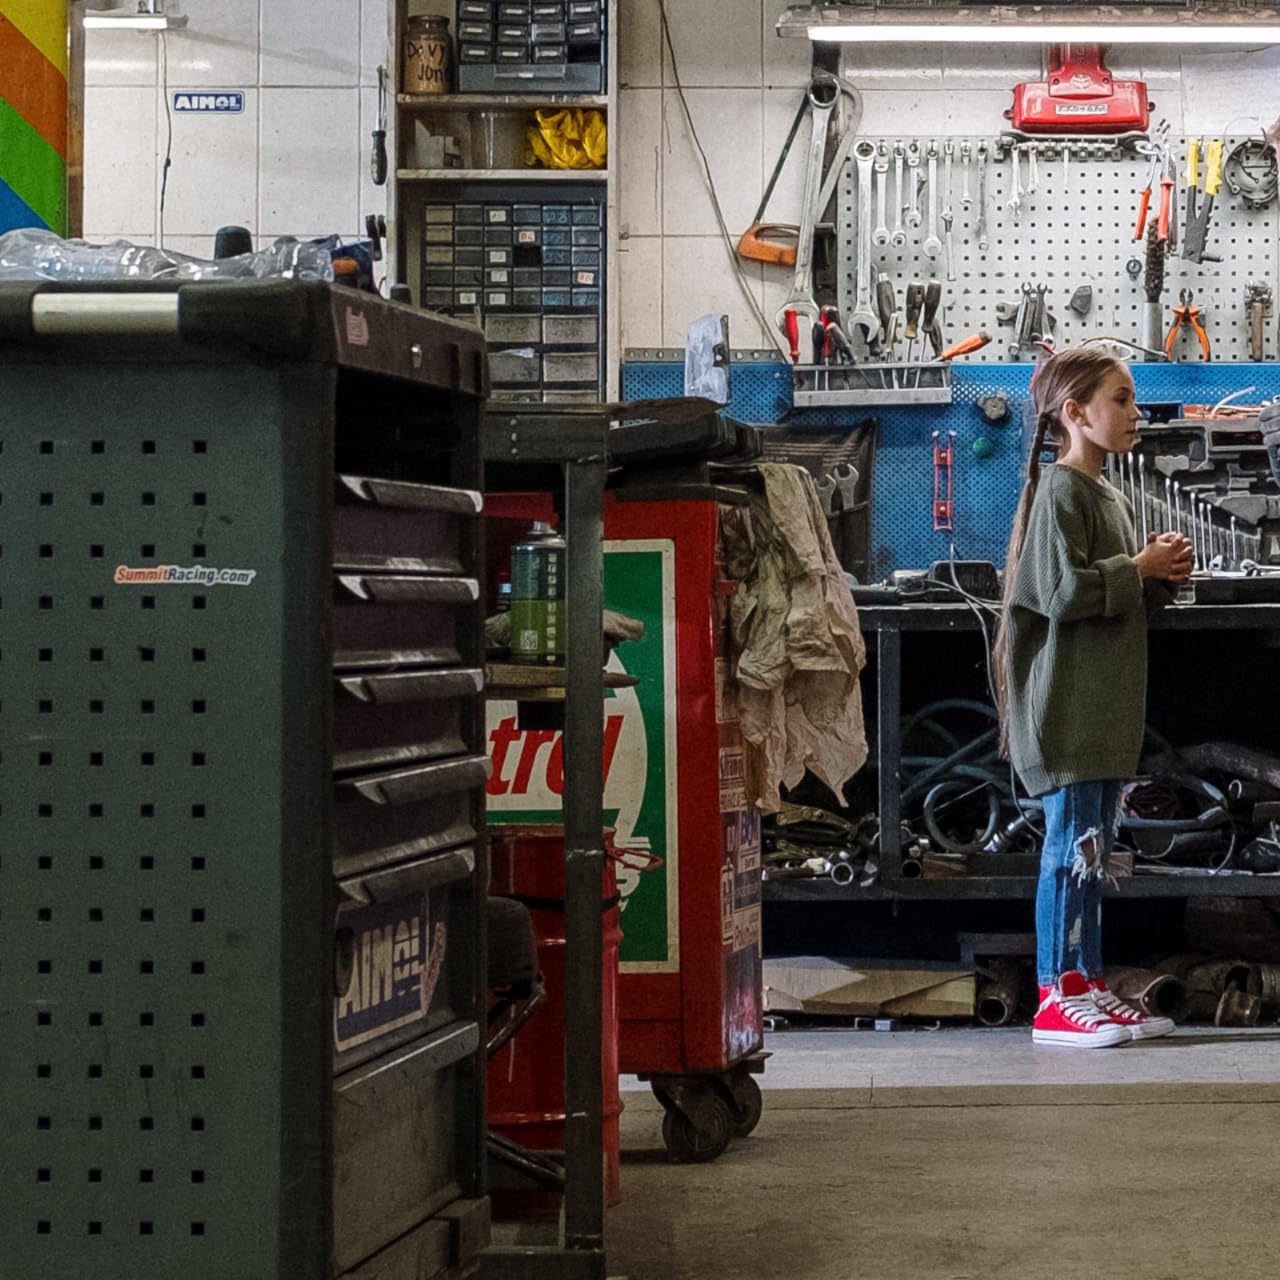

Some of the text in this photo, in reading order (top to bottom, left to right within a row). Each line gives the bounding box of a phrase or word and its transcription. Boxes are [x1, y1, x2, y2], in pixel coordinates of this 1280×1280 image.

[175, 95, 241, 110] AIMOL
[116, 566, 251, 583] SummitRacing.com
[338, 916, 426, 1019] AIMOL
